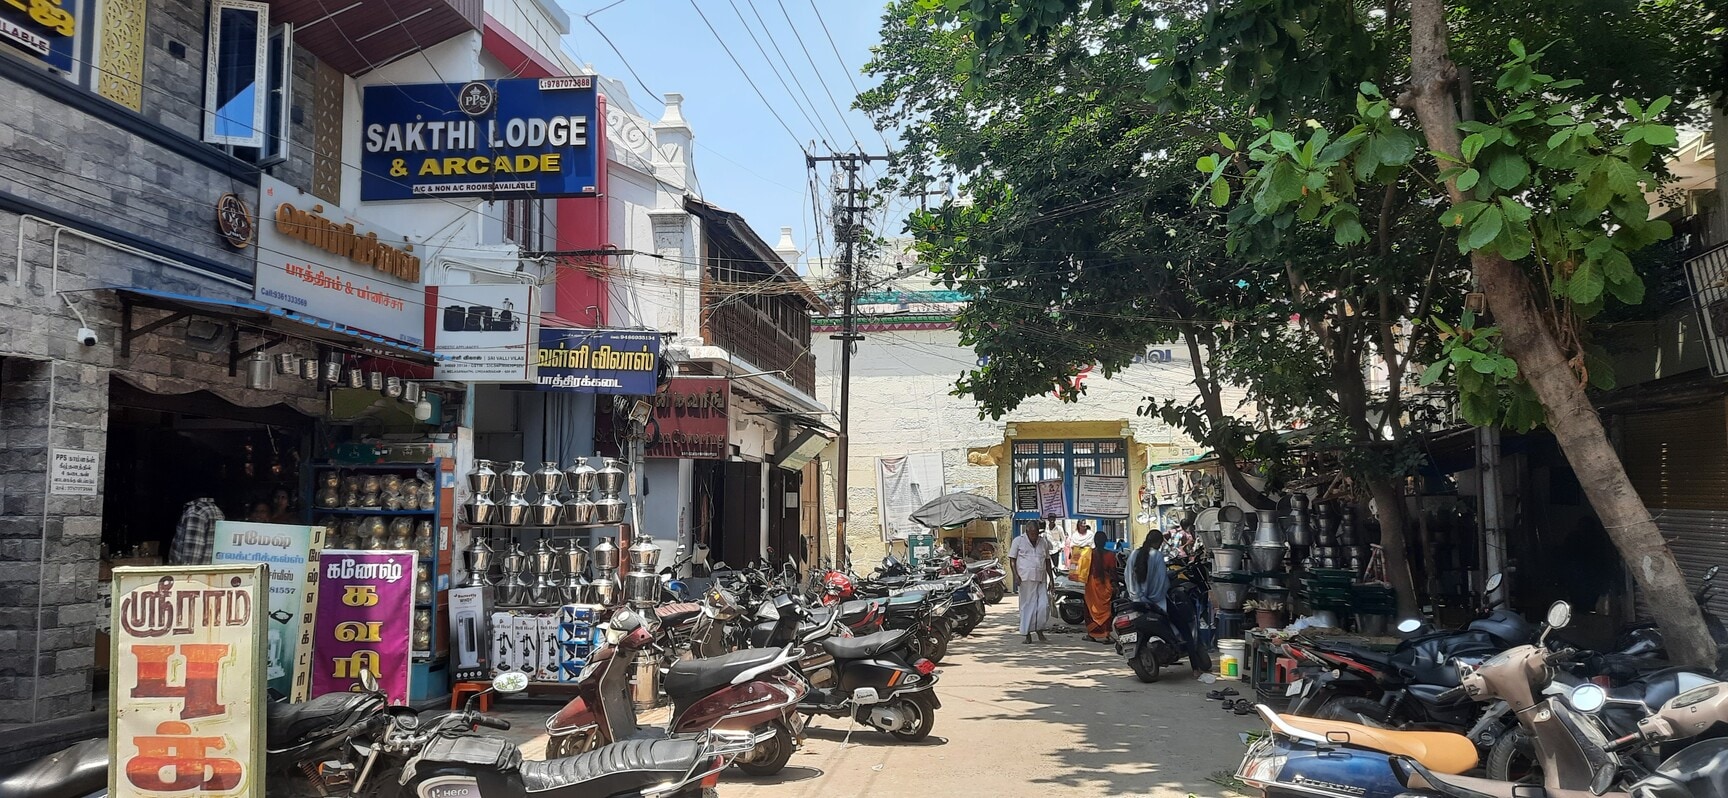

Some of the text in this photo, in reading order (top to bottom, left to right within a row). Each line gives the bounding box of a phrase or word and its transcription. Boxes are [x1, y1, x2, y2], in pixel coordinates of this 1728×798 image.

[465, 94, 488, 106] PPS
[366, 115, 587, 152] SAKTHI LODGE
[389, 153, 561, 177] & ARCADE
[494, 181, 535, 189] AVAILABLE
[285, 262, 343, 291] பாத்திரம்
[344, 281, 353, 295] &
[537, 342, 654, 371] வள்ளி விலாஸ்
[537, 374, 623, 388] பாத்திரக்கடை
[327, 558, 402, 583] கணேஷ்
